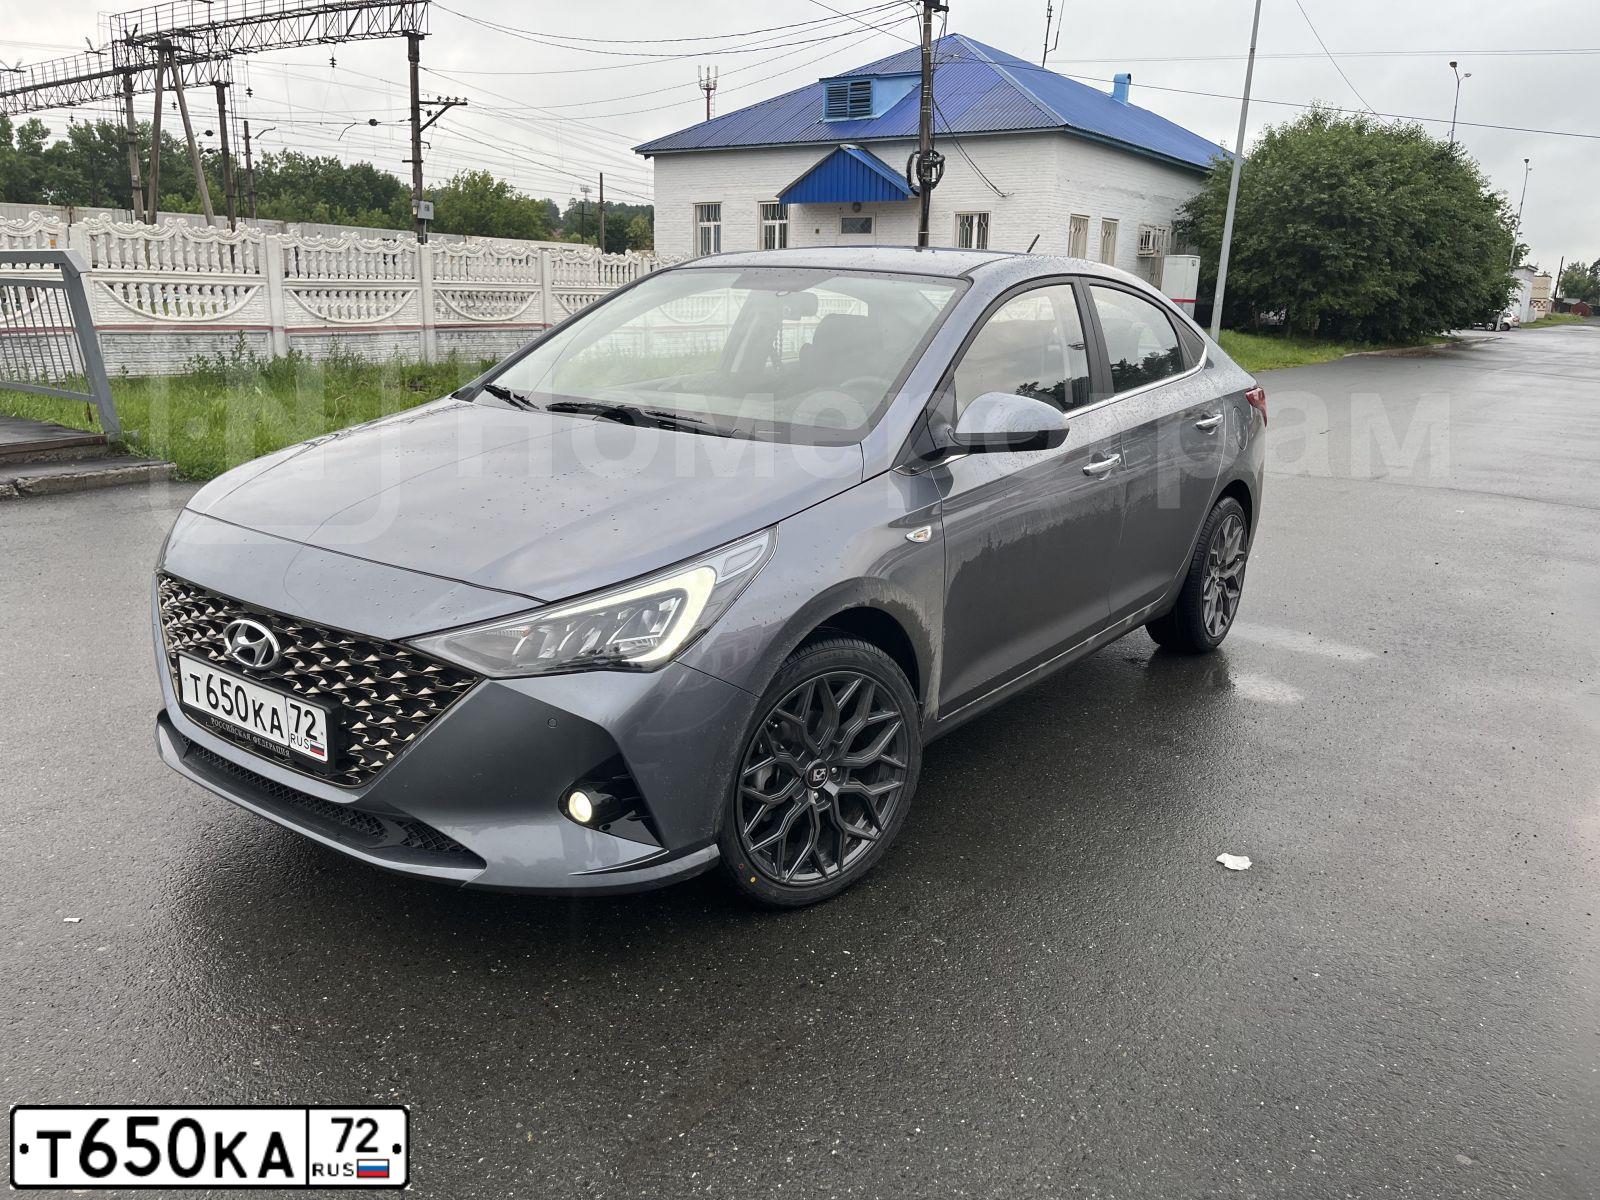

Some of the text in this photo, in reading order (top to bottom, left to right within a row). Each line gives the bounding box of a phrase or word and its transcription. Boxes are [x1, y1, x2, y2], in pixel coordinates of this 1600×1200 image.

[189, 673, 284, 739] Т650КА
[289, 702, 318, 741] 72
[290, 734, 310, 750] RUS
